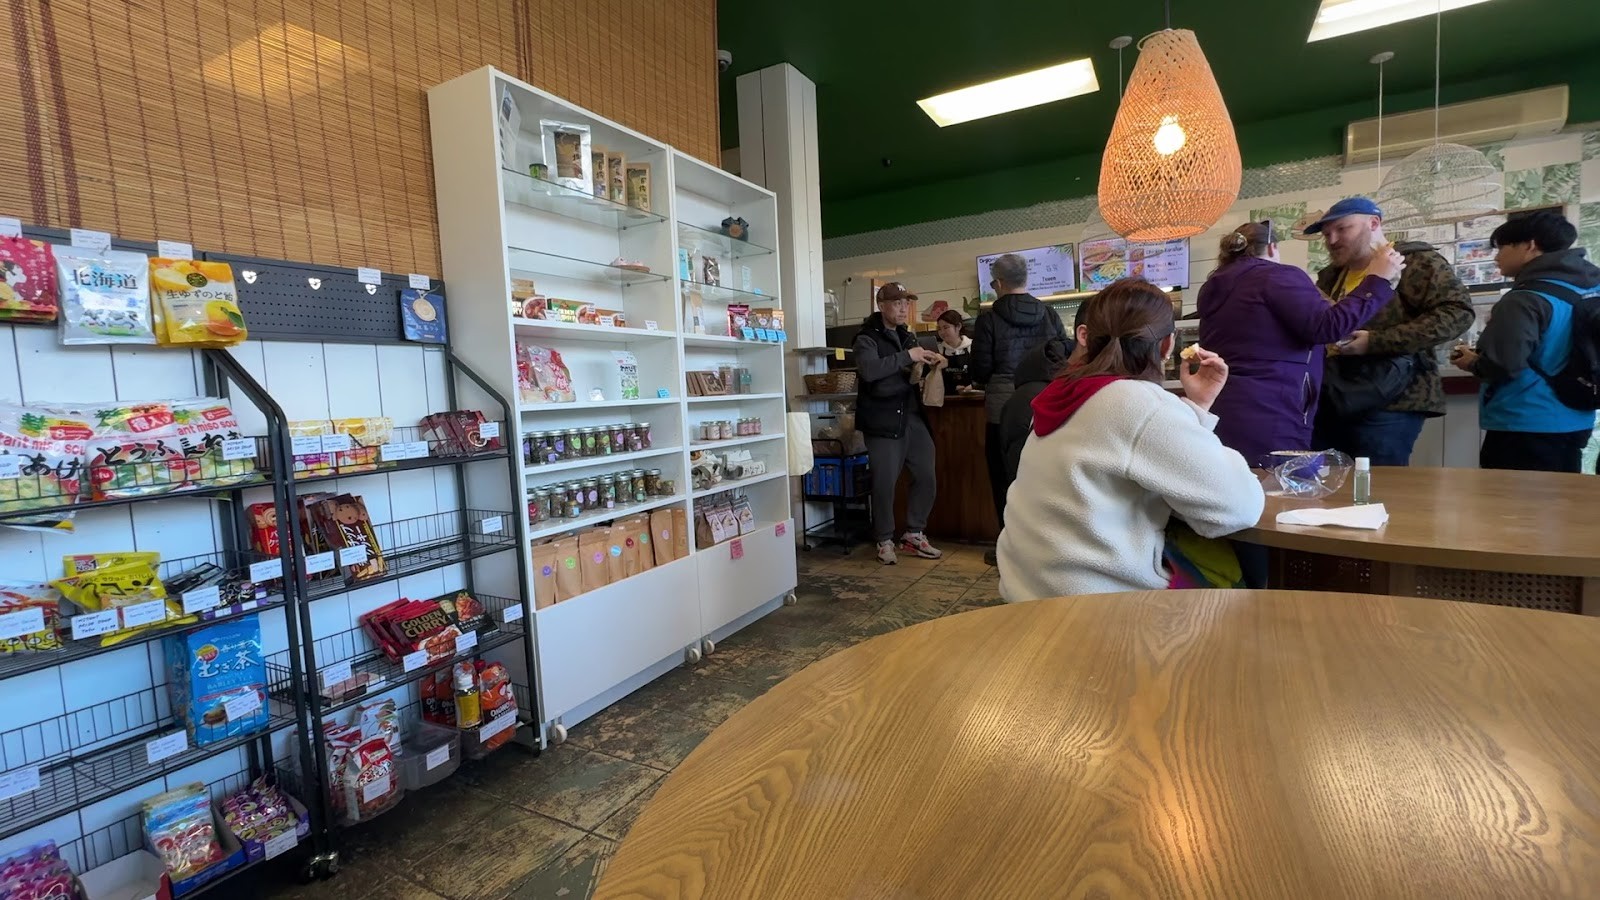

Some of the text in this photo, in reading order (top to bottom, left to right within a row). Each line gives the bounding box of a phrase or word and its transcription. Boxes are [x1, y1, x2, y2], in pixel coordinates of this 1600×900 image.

[72, 268, 139, 290] 北海道
[166, 289, 234, 302] 生ゆずのど飴
[177, 419, 238, 436] ant miso sou
[96, 439, 176, 465] とうふ
[401, 609, 443, 629] GOLDEN
[404, 615, 448, 638] CURRY
[192, 649, 260, 678] むぎ茶
